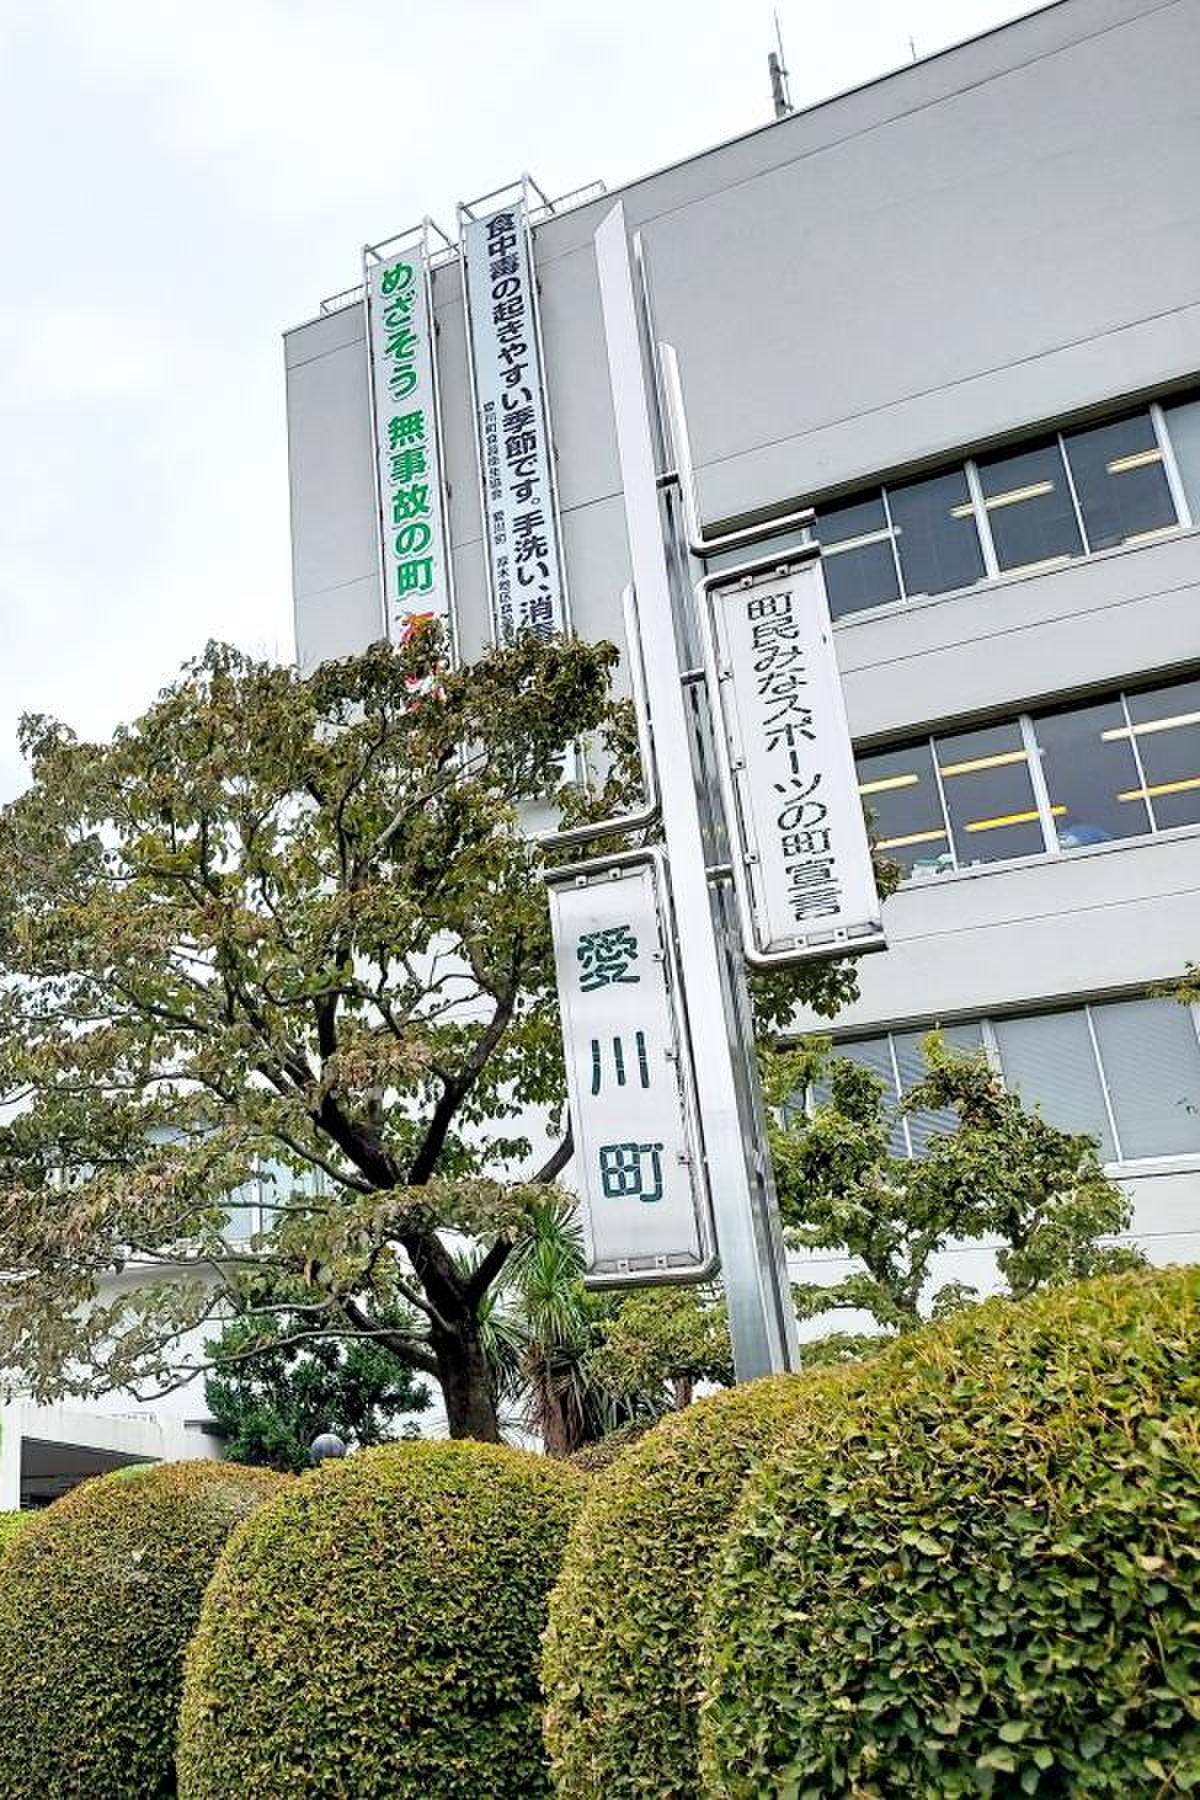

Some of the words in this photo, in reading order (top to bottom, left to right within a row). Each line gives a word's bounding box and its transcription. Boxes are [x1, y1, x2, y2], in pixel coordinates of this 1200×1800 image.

[380, 262, 419, 400] めざそう
[387, 409, 434, 596] 無事故の町
[746, 590, 841, 921] 町民みなスポーツの町宣言
[577, 924, 665, 1203] 愛川町
